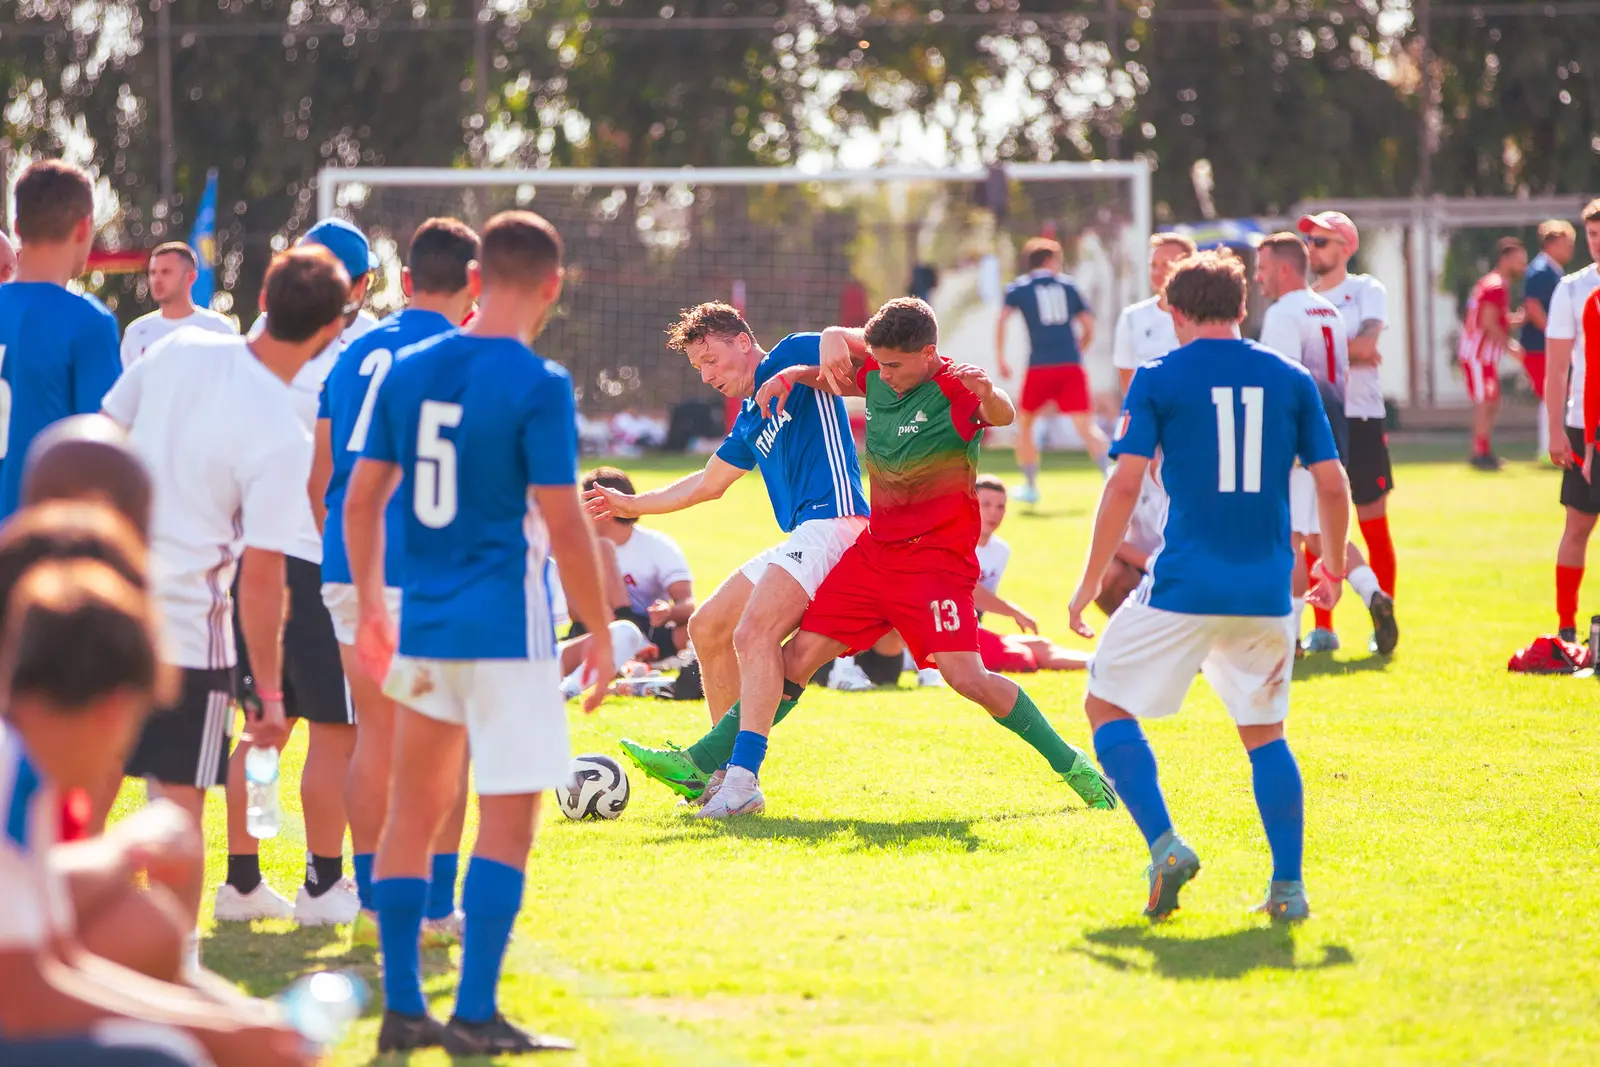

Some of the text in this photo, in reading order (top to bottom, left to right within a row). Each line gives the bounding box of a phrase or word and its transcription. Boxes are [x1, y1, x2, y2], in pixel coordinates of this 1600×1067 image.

[755, 409, 793, 459] ITALIA
[897, 425, 920, 437] pwc
[1211, 386, 1264, 493] 11
[413, 399, 464, 529] 5
[930, 599, 961, 632] 13
